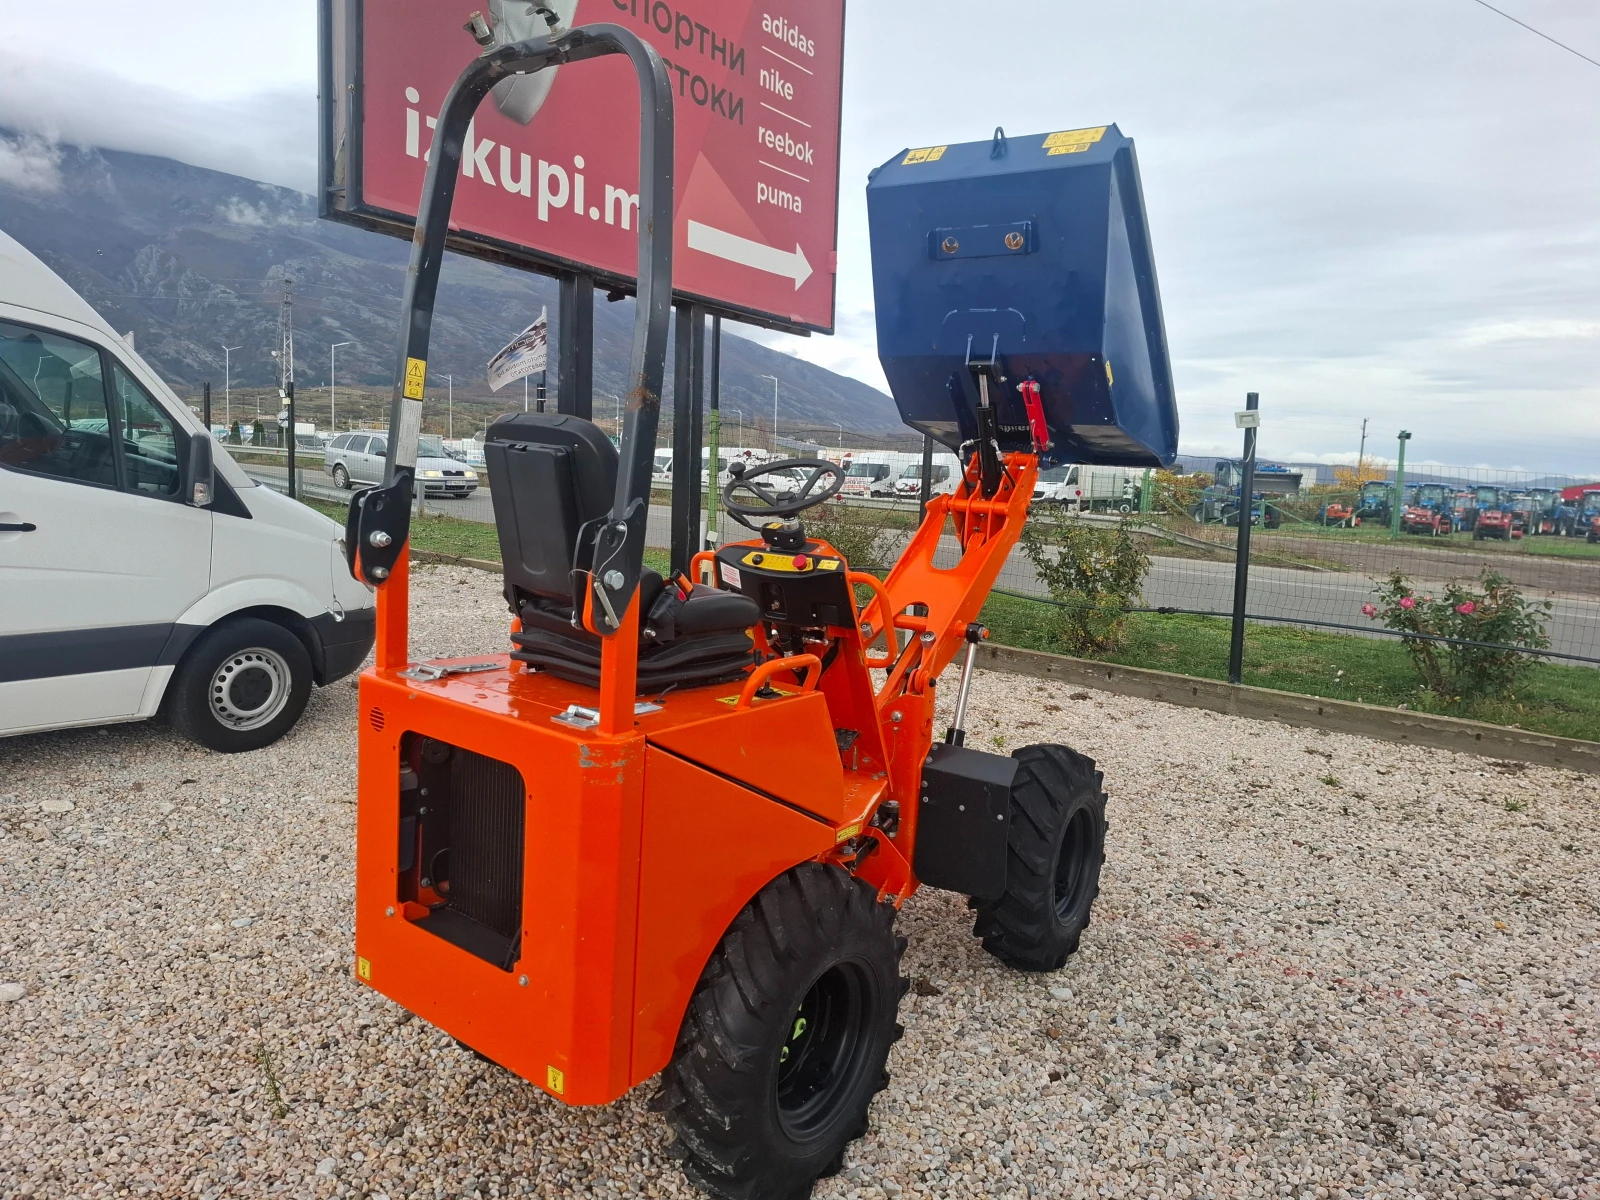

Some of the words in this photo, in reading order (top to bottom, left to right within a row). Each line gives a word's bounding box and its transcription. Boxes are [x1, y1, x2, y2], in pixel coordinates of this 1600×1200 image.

[762, 13, 815, 57] adidas
[661, 57, 744, 126] токи
[760, 68, 794, 101] nike
[758, 126, 814, 165] reebok
[757, 181, 802, 213] puma
